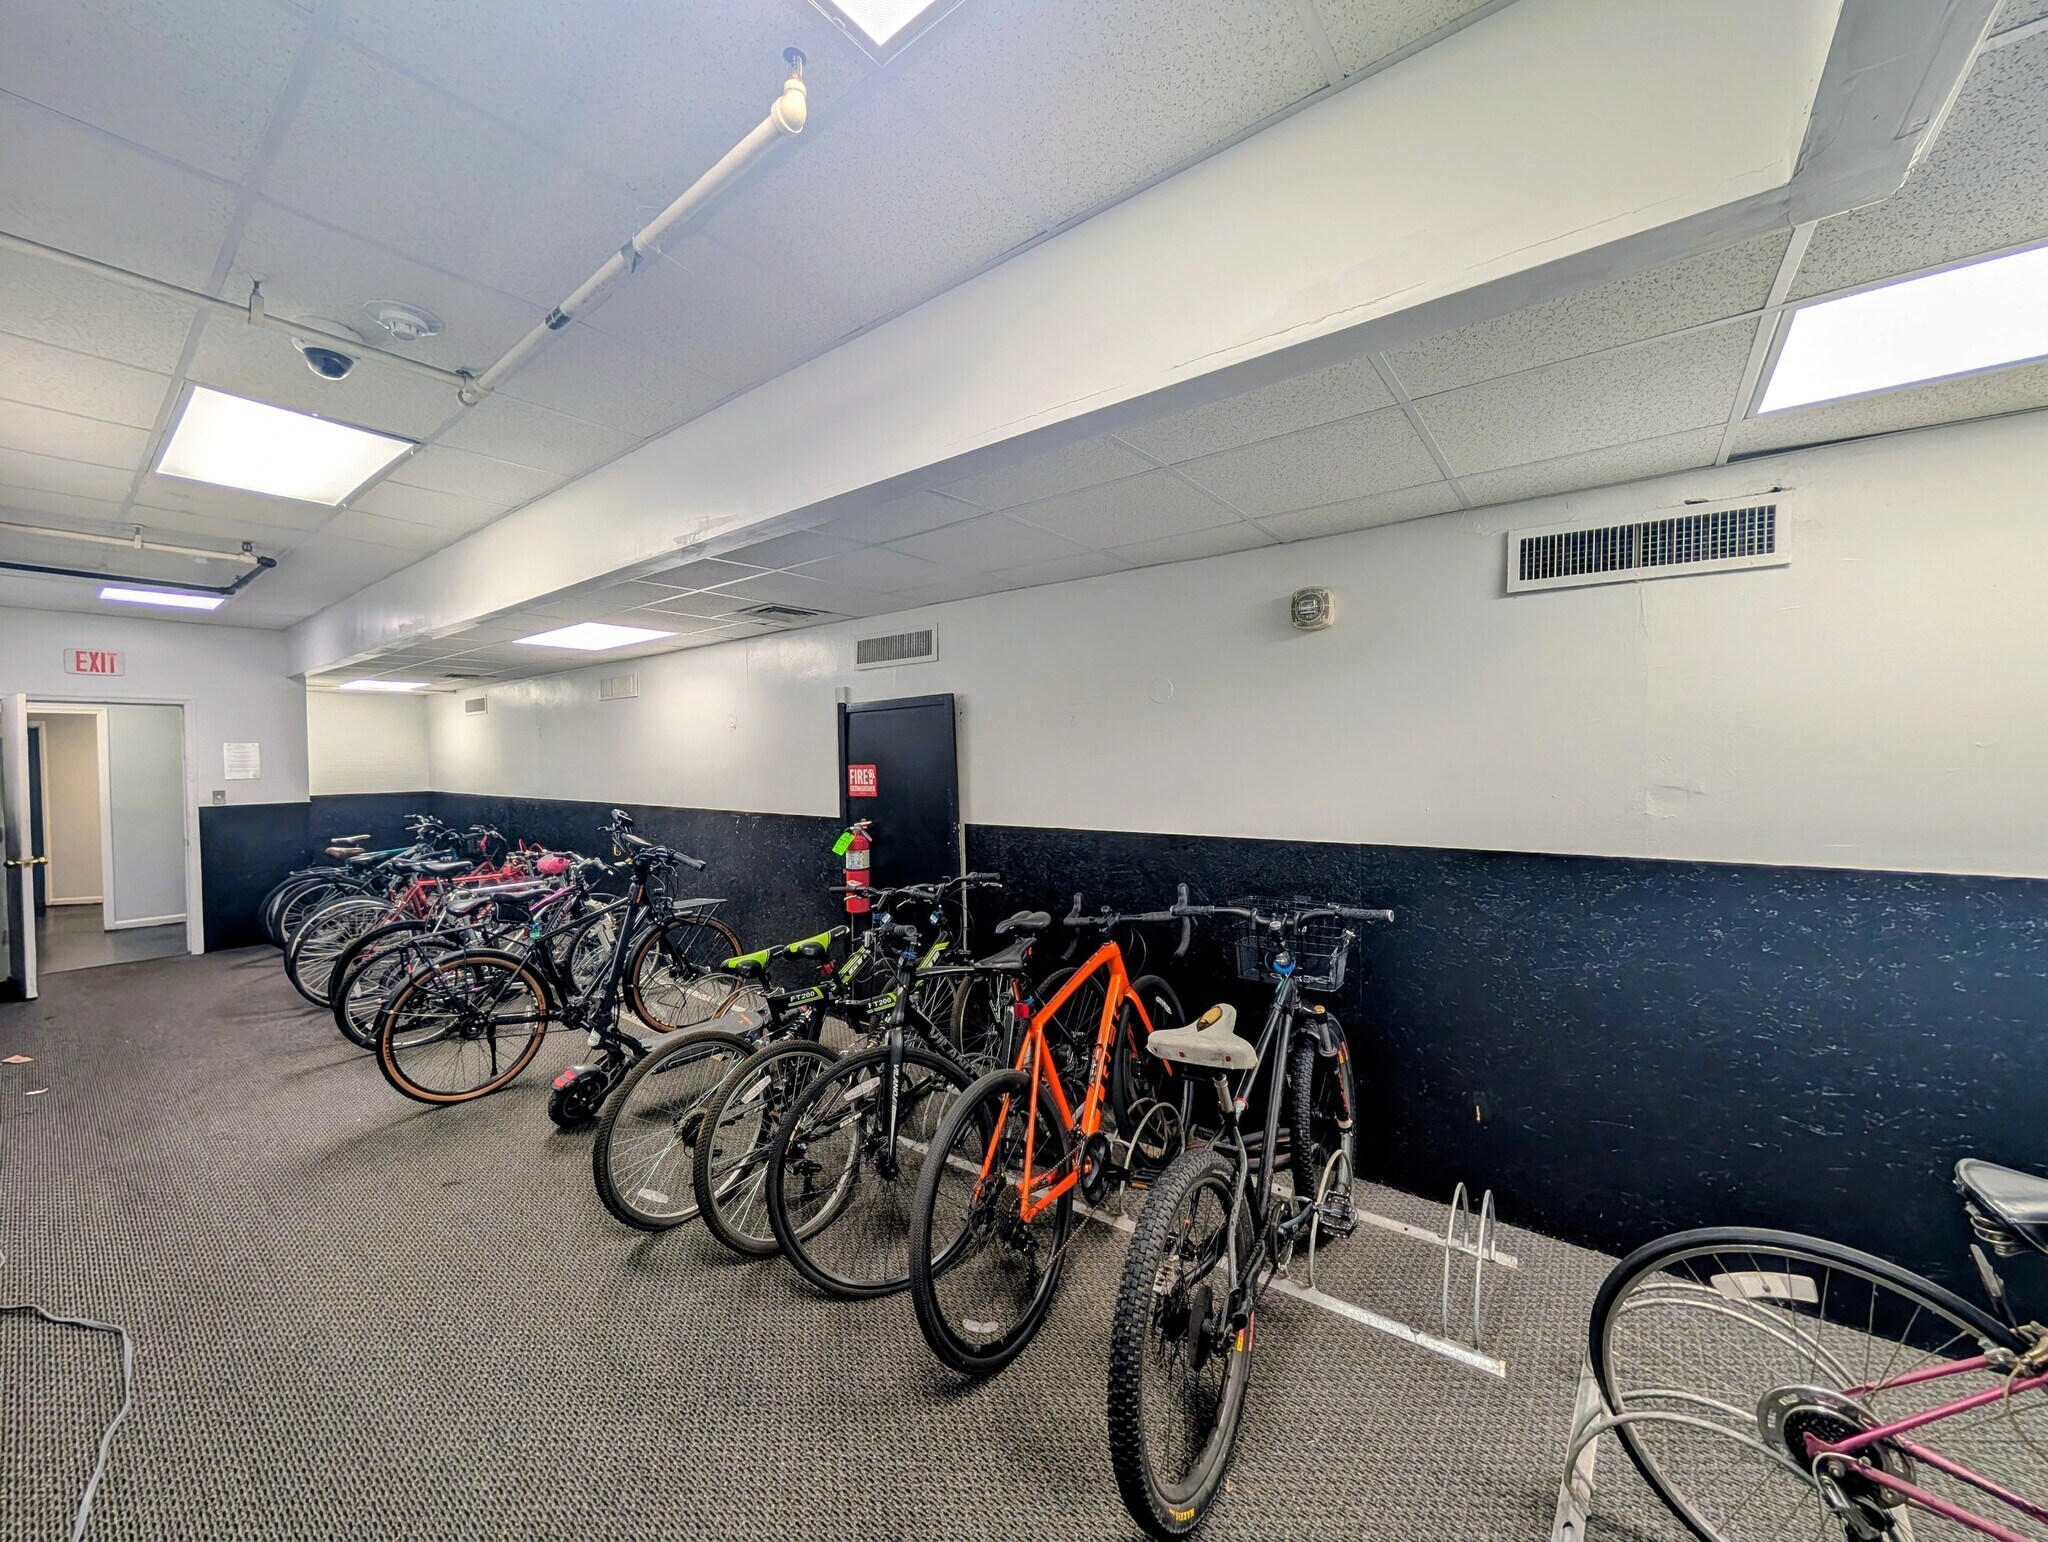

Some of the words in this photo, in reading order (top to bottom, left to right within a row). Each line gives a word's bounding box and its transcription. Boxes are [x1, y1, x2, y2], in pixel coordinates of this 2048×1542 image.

[75, 651, 118, 673] EXIT
[850, 769, 869, 785] FIRE
[790, 990, 816, 1002] FT200
[867, 997, 892, 1009] FT200
[892, 1064, 900, 1098] VILANO
